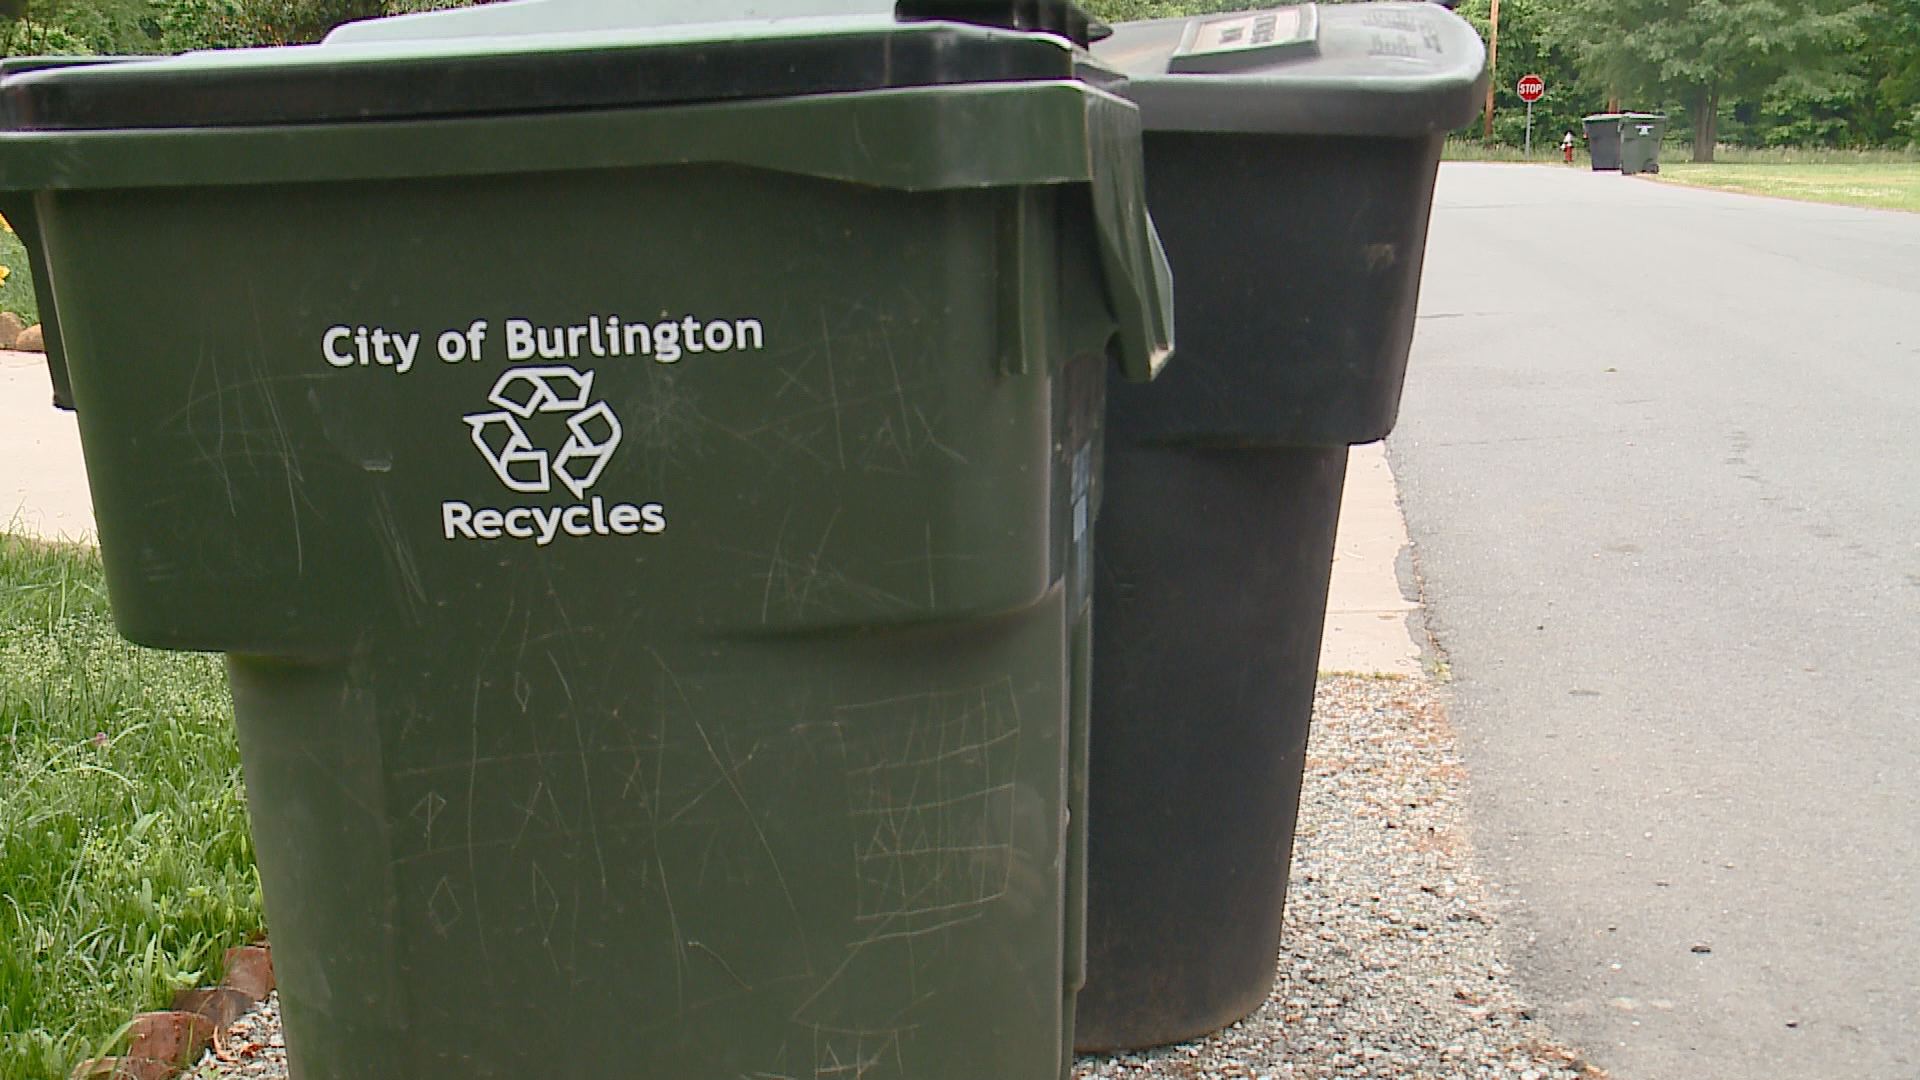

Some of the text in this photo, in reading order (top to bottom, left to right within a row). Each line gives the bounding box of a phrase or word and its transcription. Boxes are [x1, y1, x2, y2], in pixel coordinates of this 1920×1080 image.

[1520, 83, 1542, 95] STOP
[322, 315, 764, 372] City of Burlington
[443, 497, 666, 546] Recycles
